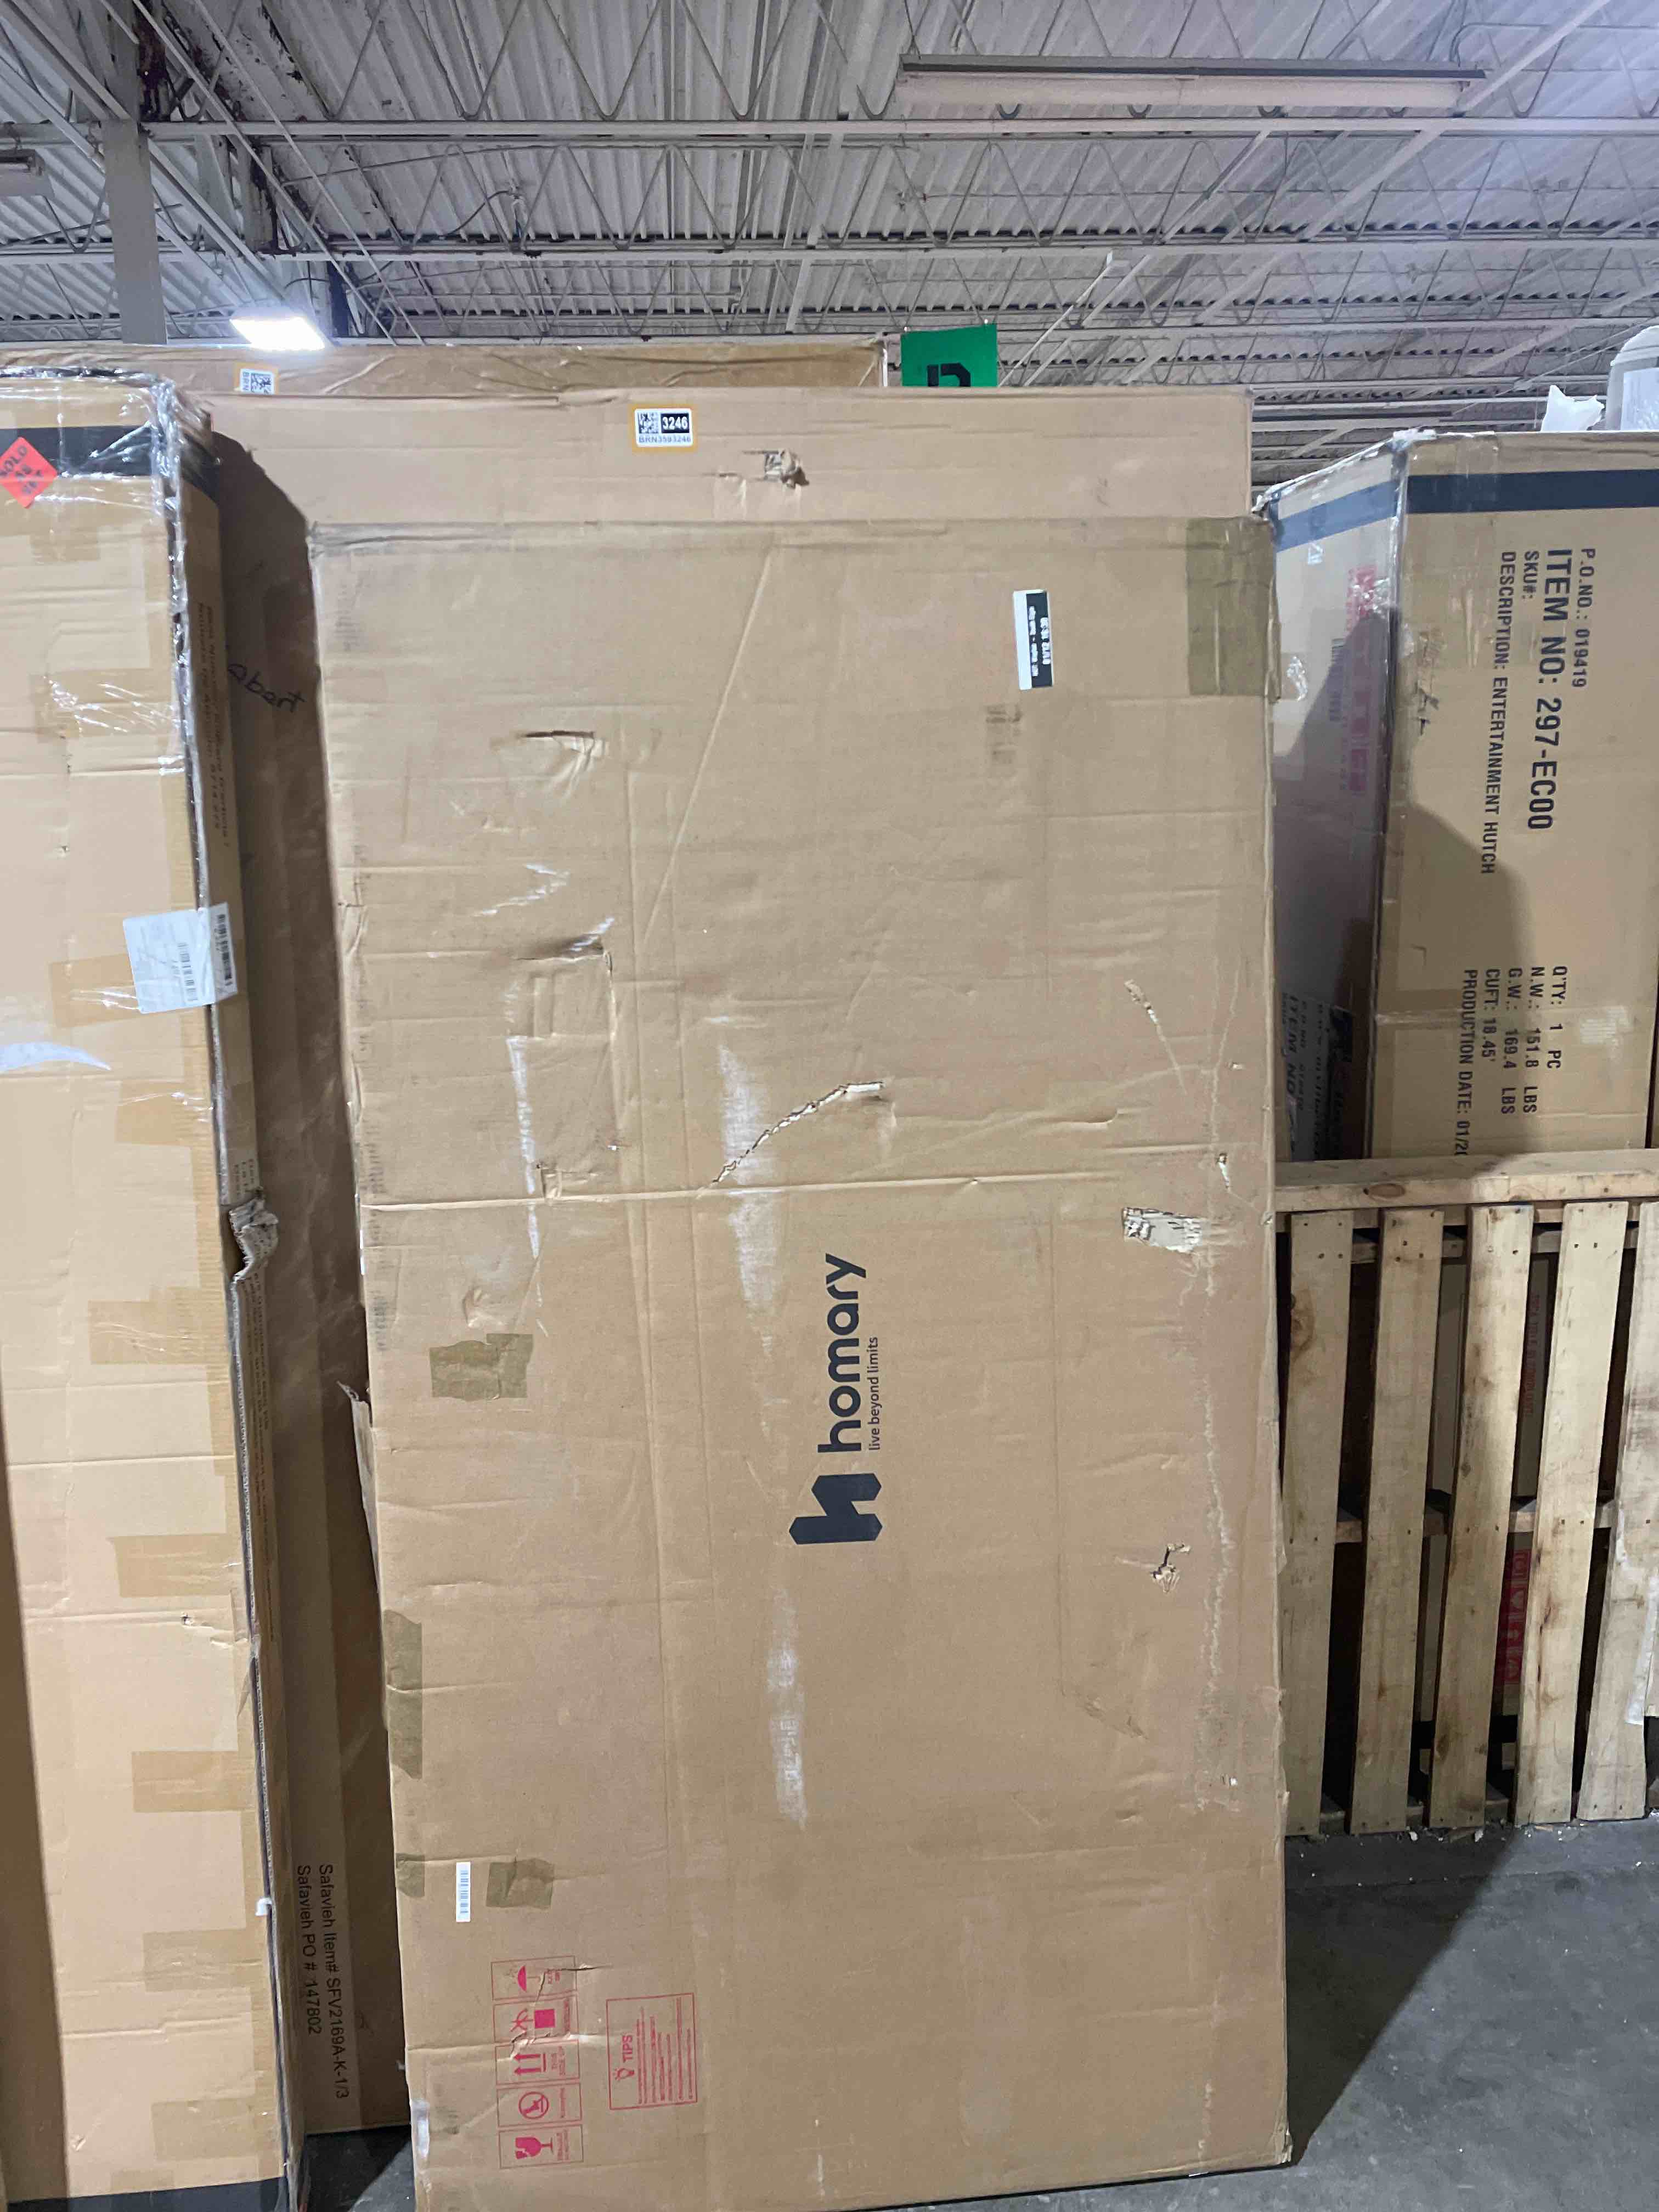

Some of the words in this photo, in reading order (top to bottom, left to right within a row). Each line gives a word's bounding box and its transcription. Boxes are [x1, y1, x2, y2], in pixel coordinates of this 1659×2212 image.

[662, 416, 688, 430] 3246
[1521, 551, 1539, 600] SKU#:
[1542, 549, 1572, 622] ITEM
[1493, 551, 1516, 670] DESCRIPTION:
[1537, 636, 1566, 684] NO:
[1571, 629, 1590, 688] 019419
[1484, 677, 1508, 815] ENTERTAINMENT
[1480, 822, 1499, 874] HUTCH
[1482, 968, 1501, 1012] CUFT:
[1505, 967, 1523, 1012] G.W.:
[1527, 966, 1545, 1010] N.W.:
[1459, 969, 1479, 1064] PRODUCTION
[1548, 1023, 1564, 1031] 1
[1502, 1028, 1520, 1069] 169.4
[1523, 1028, 1542, 1068] 151.8
[1546, 1050, 1562, 1069] PC
[1457, 1070, 1474, 1115] DATE:
[1500, 1087, 1516, 1115] LBS
[1522, 1086, 1538, 1113] LBS
[817, 1253, 866, 1453] homary
[867, 1336, 879, 1374] limits
[867, 1376, 882, 1425] beyond
[868, 1427, 881, 1451] live
[297, 1865, 314, 1930] Safavieh
[319, 1864, 336, 1929] Safavieh
[302, 1932, 316, 1956] PO
[304, 1959, 318, 1972] #
[324, 1931, 341, 1975] Item#
[305, 1976, 324, 2035] 147802
[326, 1976, 349, 2099] SFV2169A-K-1/3
[622, 2035, 633, 2063] TIPS
